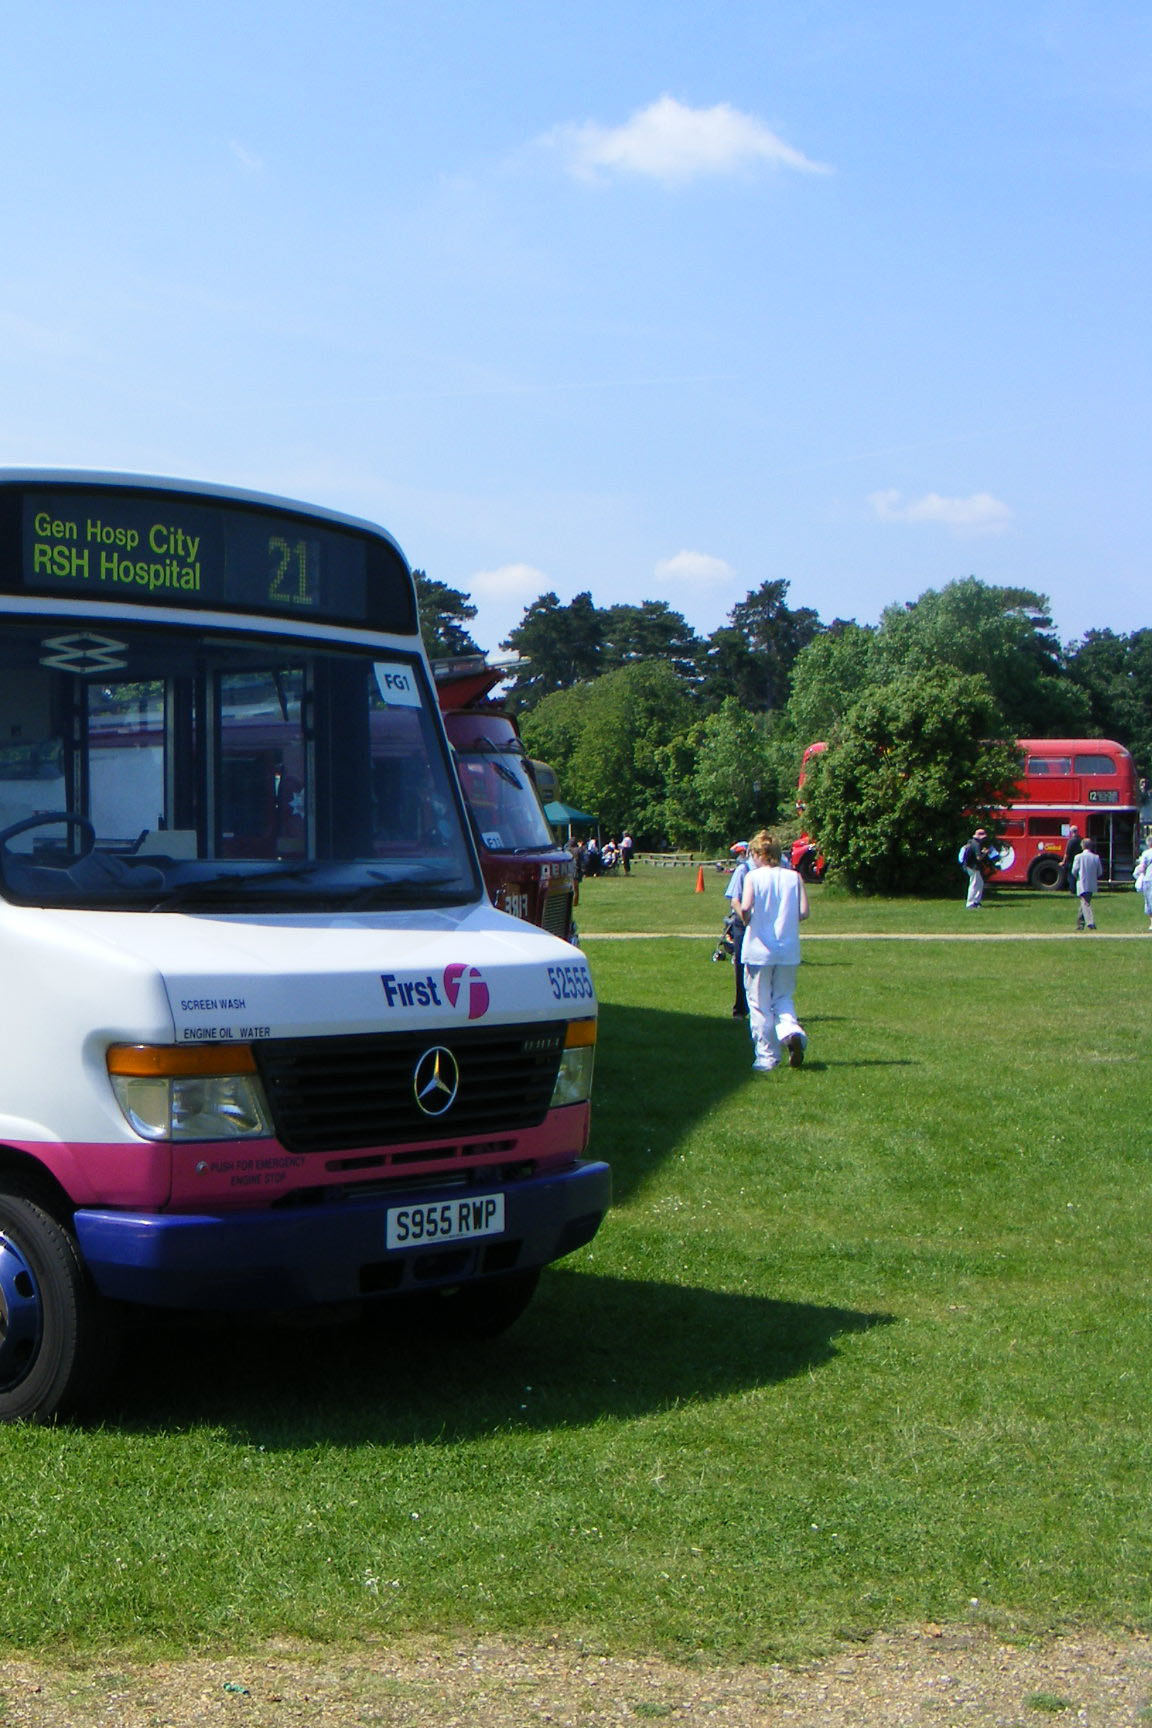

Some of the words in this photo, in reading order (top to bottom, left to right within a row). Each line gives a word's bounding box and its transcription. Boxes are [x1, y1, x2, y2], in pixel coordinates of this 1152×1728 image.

[34, 512, 77, 539] Gen
[86, 519, 139, 551] Hosp
[149, 524, 200, 563] City
[34, 543, 89, 578] RSH
[100, 551, 200, 590] Hospital
[268, 535, 313, 605] 21
[384, 674, 410, 691] FG1
[380, 974, 442, 1007] First
[547, 967, 593, 1000] 52555
[181, 999, 218, 1011] SCREEN
[219, 999, 246, 1010] WASH
[184, 1028, 217, 1039] ENGINE
[219, 1027, 234, 1038] OIL
[240, 1026, 271, 1038] WATER
[236, 1159, 254, 1171] FOR
[255, 1156, 305, 1170] EMERGENCY
[397, 1205, 452, 1241] S955
[458, 1199, 497, 1233] RWP
